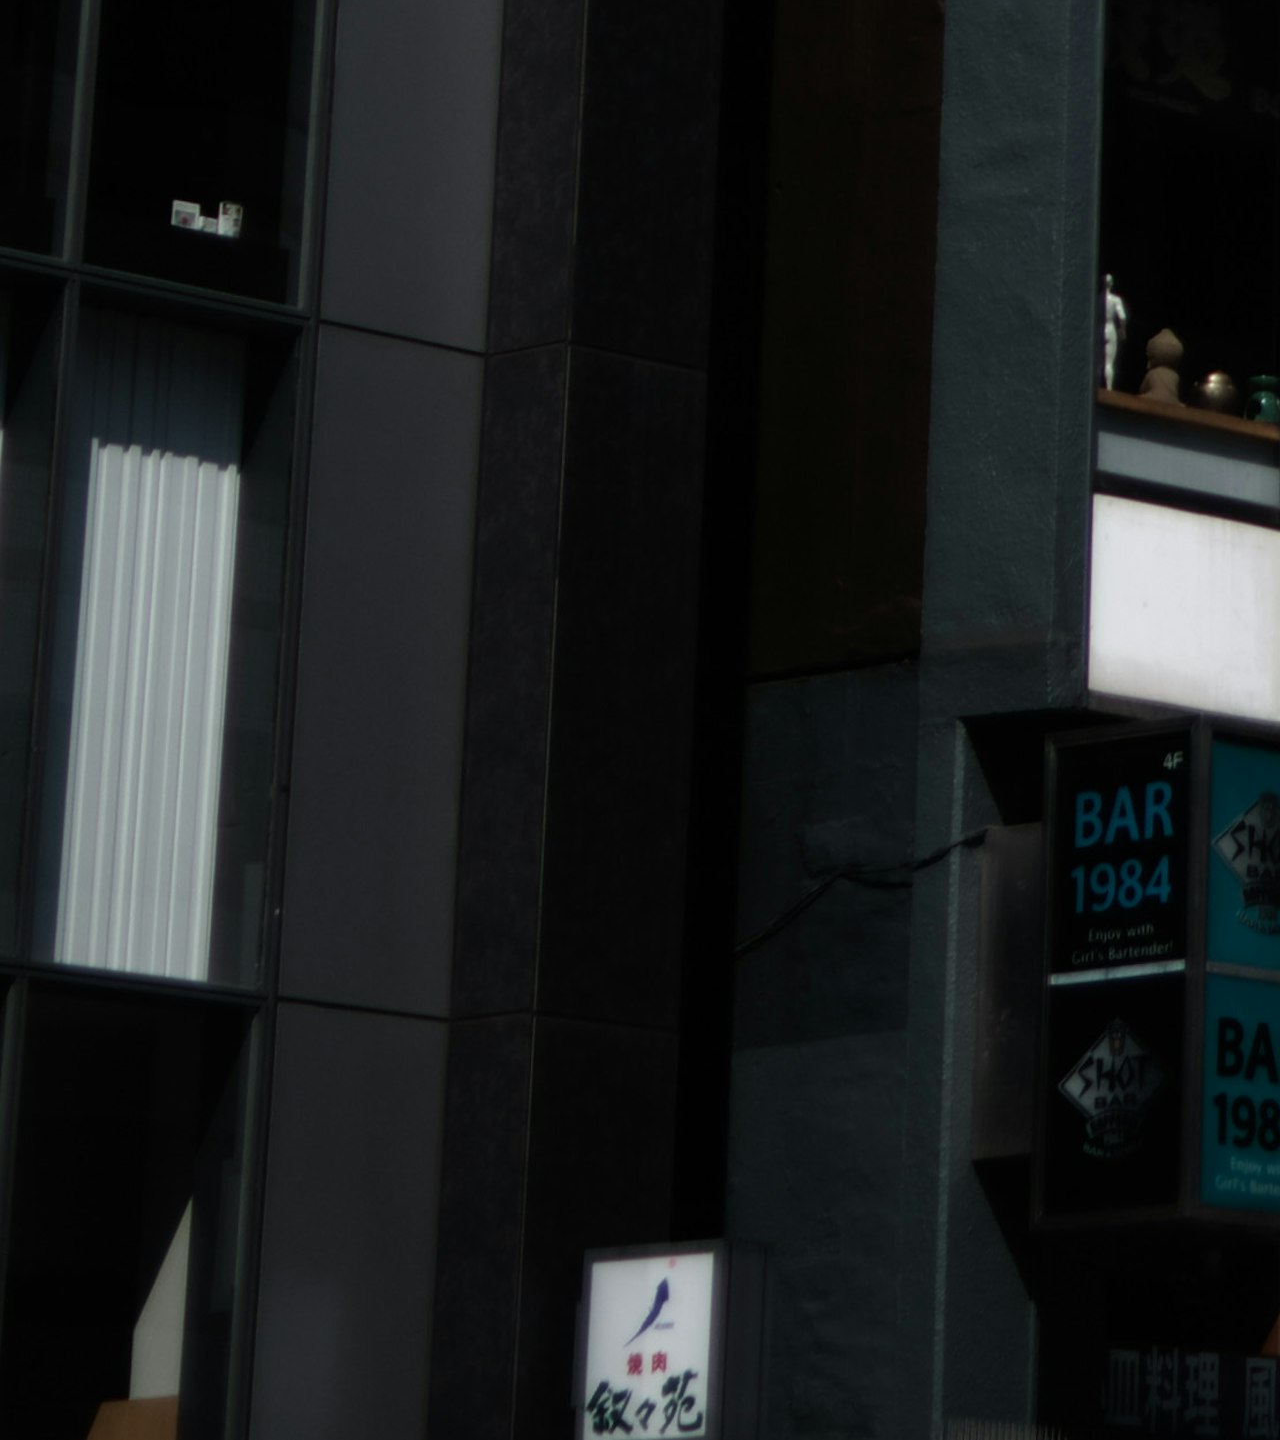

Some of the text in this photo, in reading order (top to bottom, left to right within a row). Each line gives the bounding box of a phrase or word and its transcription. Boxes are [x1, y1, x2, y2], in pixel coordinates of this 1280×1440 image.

[1162, 750, 1184, 772] 4F
[1073, 780, 1174, 850] BAR
[1070, 853, 1172, 916] 1984
[627, 1352, 668, 1376] 焼肉
